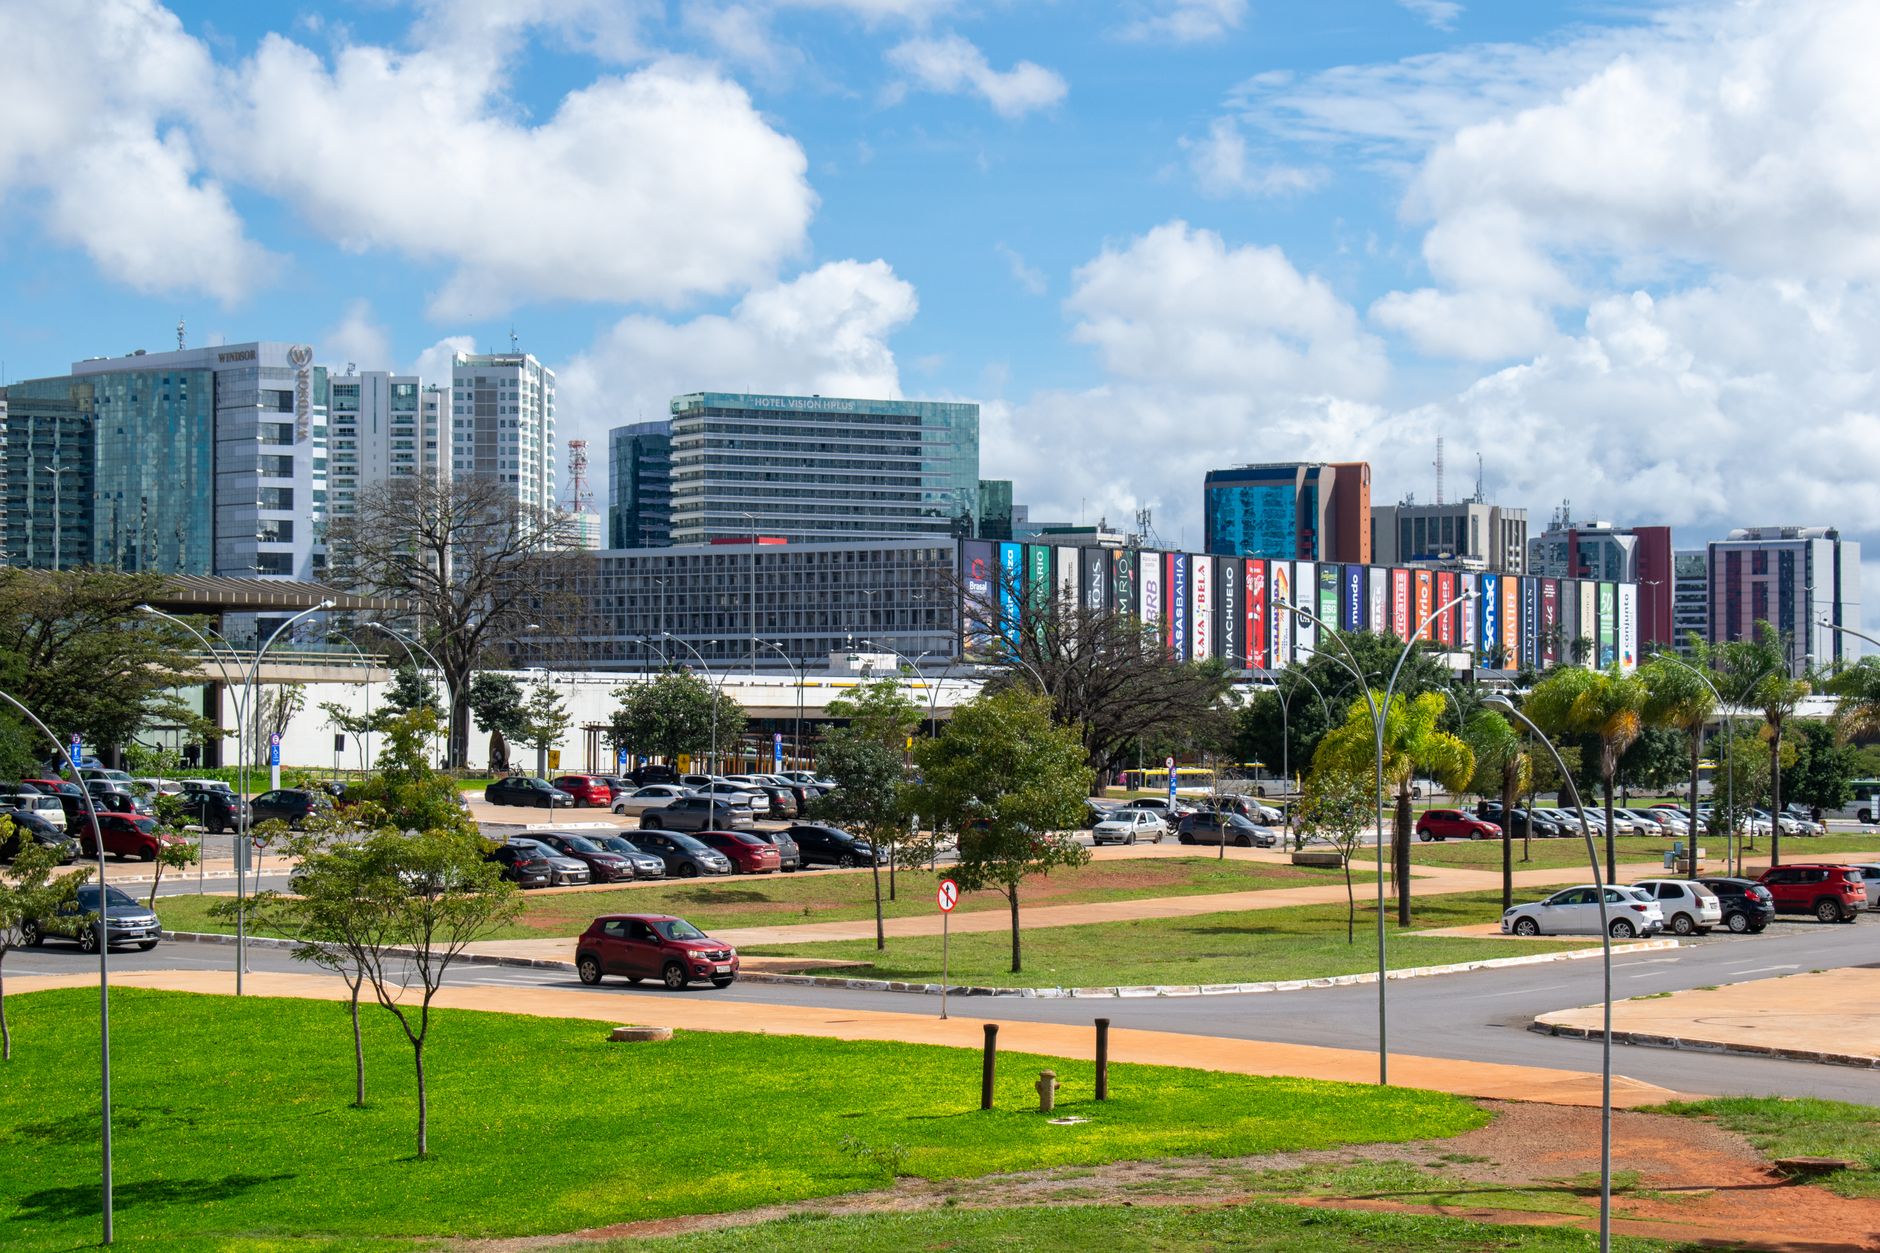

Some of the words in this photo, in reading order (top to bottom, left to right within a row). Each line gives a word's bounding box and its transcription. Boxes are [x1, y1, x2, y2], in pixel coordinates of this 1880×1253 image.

[218, 350, 256, 363] WINDSOR
[297, 369, 310, 438] WINDSOR
[754, 398, 786, 408] HOTEL
[788, 399, 822, 409] VISION
[823, 401, 854, 410] HPLUS
[969, 581, 987, 590] Brasal
[1119, 559, 1128, 593] RIO
[1146, 580, 1157, 621] BRB
[1226, 567, 1234, 659] RIACHUELO
[1484, 579, 1494, 652] senac
[1507, 591, 1515, 648] RIATIFF
